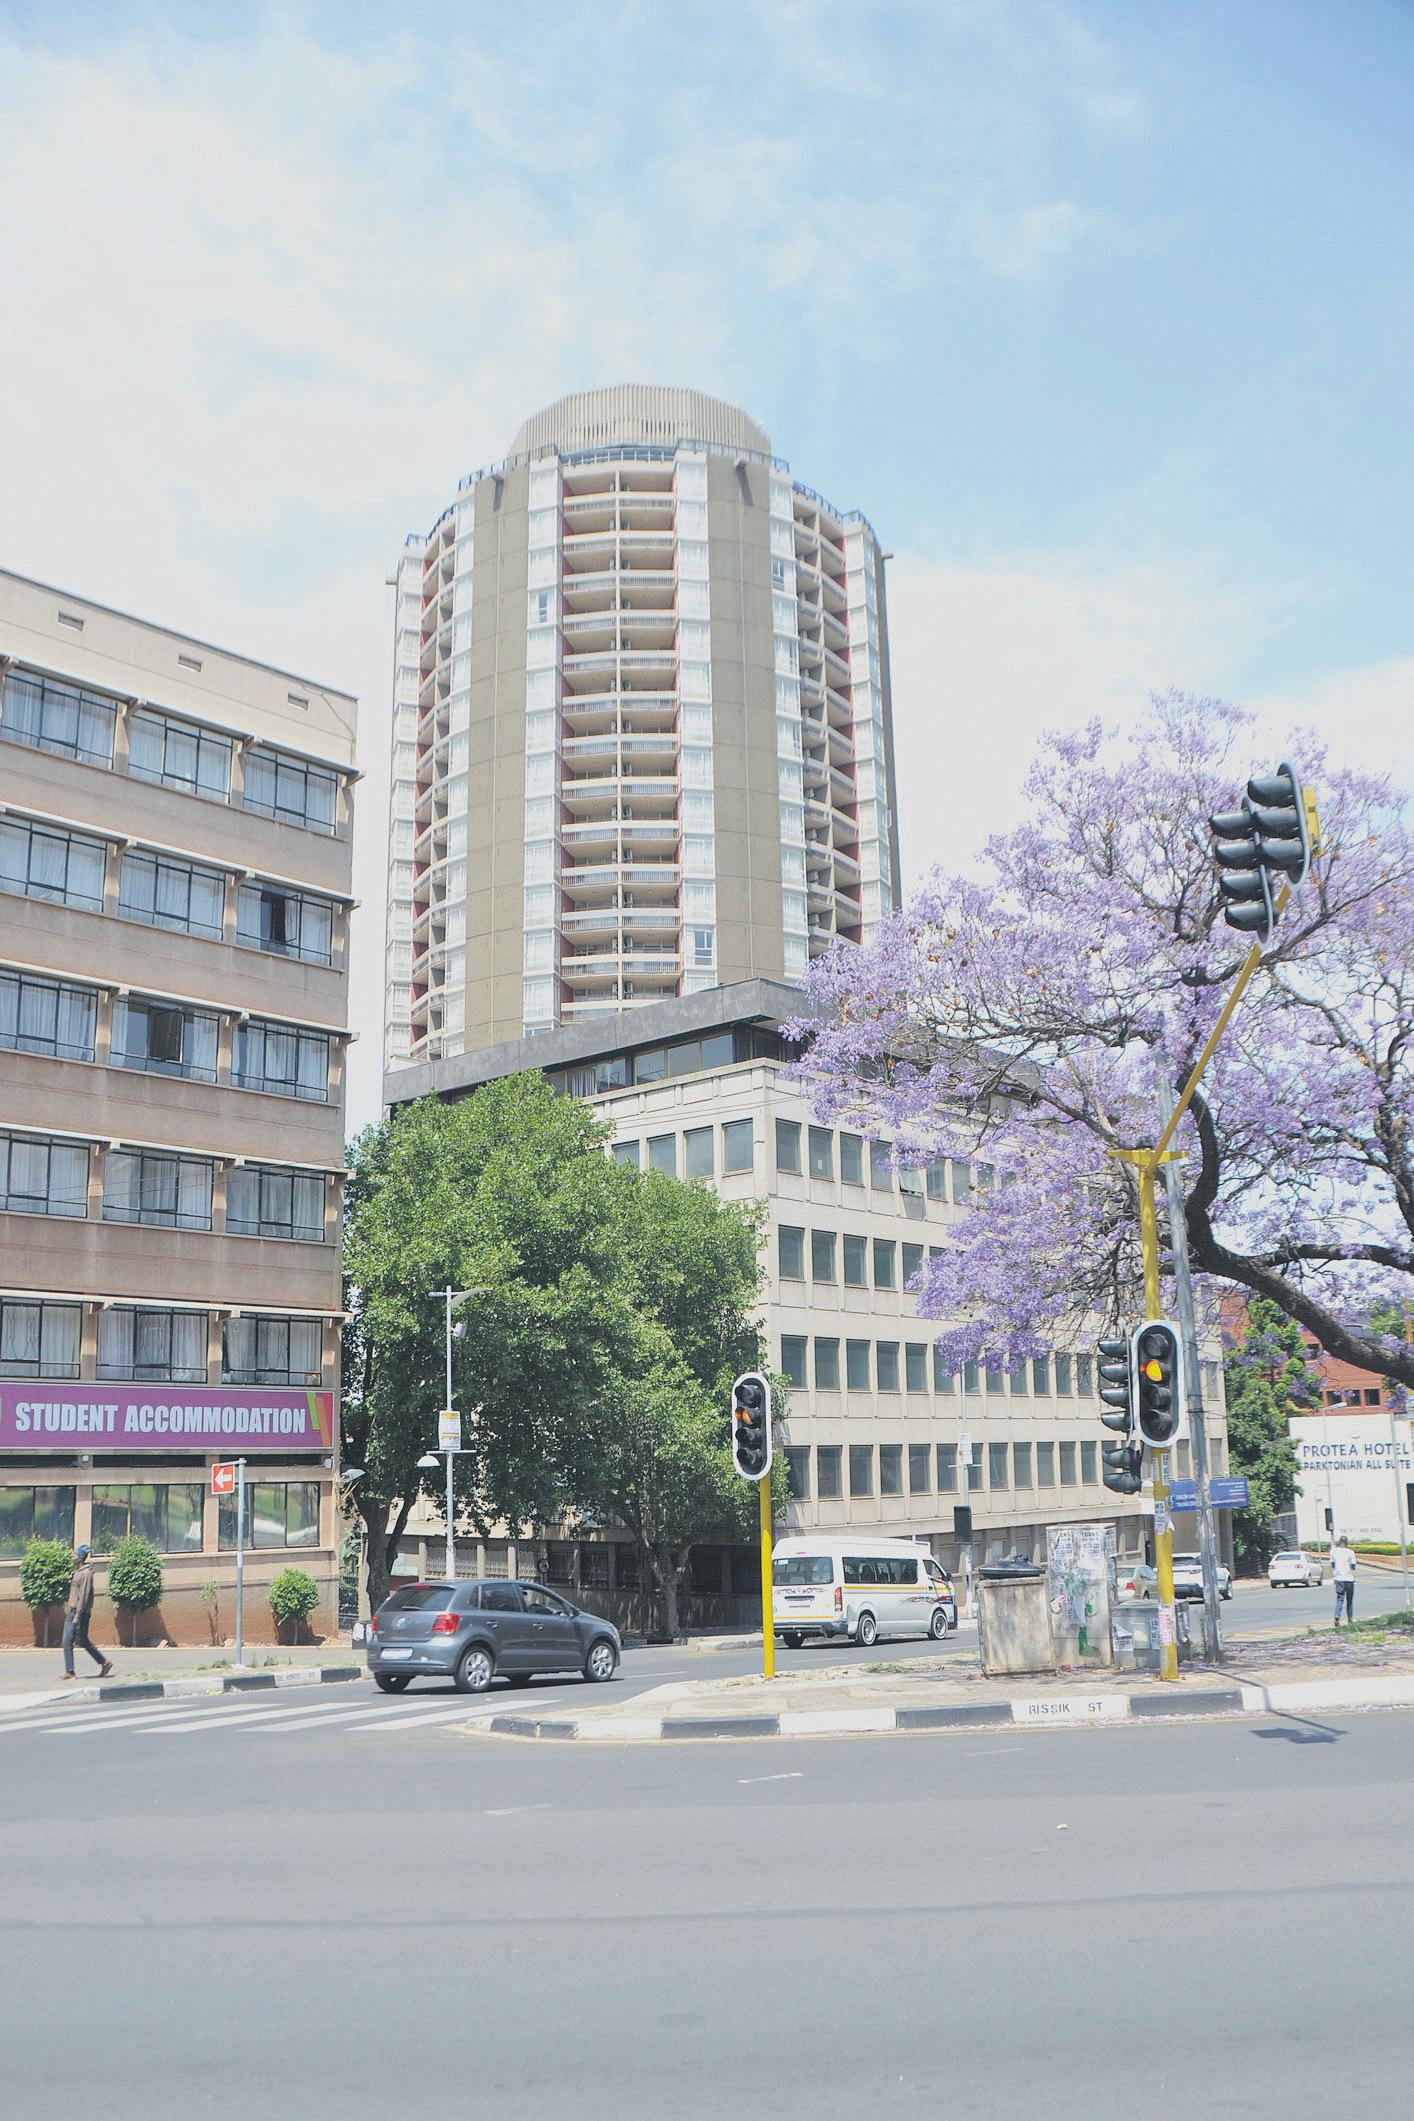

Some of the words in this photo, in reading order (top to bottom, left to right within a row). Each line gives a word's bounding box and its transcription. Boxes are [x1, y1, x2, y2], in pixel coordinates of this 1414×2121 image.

[15, 1402, 118, 1432] STUDENT
[124, 1405, 306, 1433] ACCOMMODATION
[1303, 1444, 1358, 1457] PROTEA
[1364, 1443, 1409, 1455] HOTEL
[1304, 1460, 1362, 1470] PARKTONIAN
[1366, 1460, 1382, 1469] ALL
[1385, 1460, 1411, 1469] SUTE
[1029, 1703, 1070, 1715] RISSIK
[1088, 1702, 1103, 1712] ST
